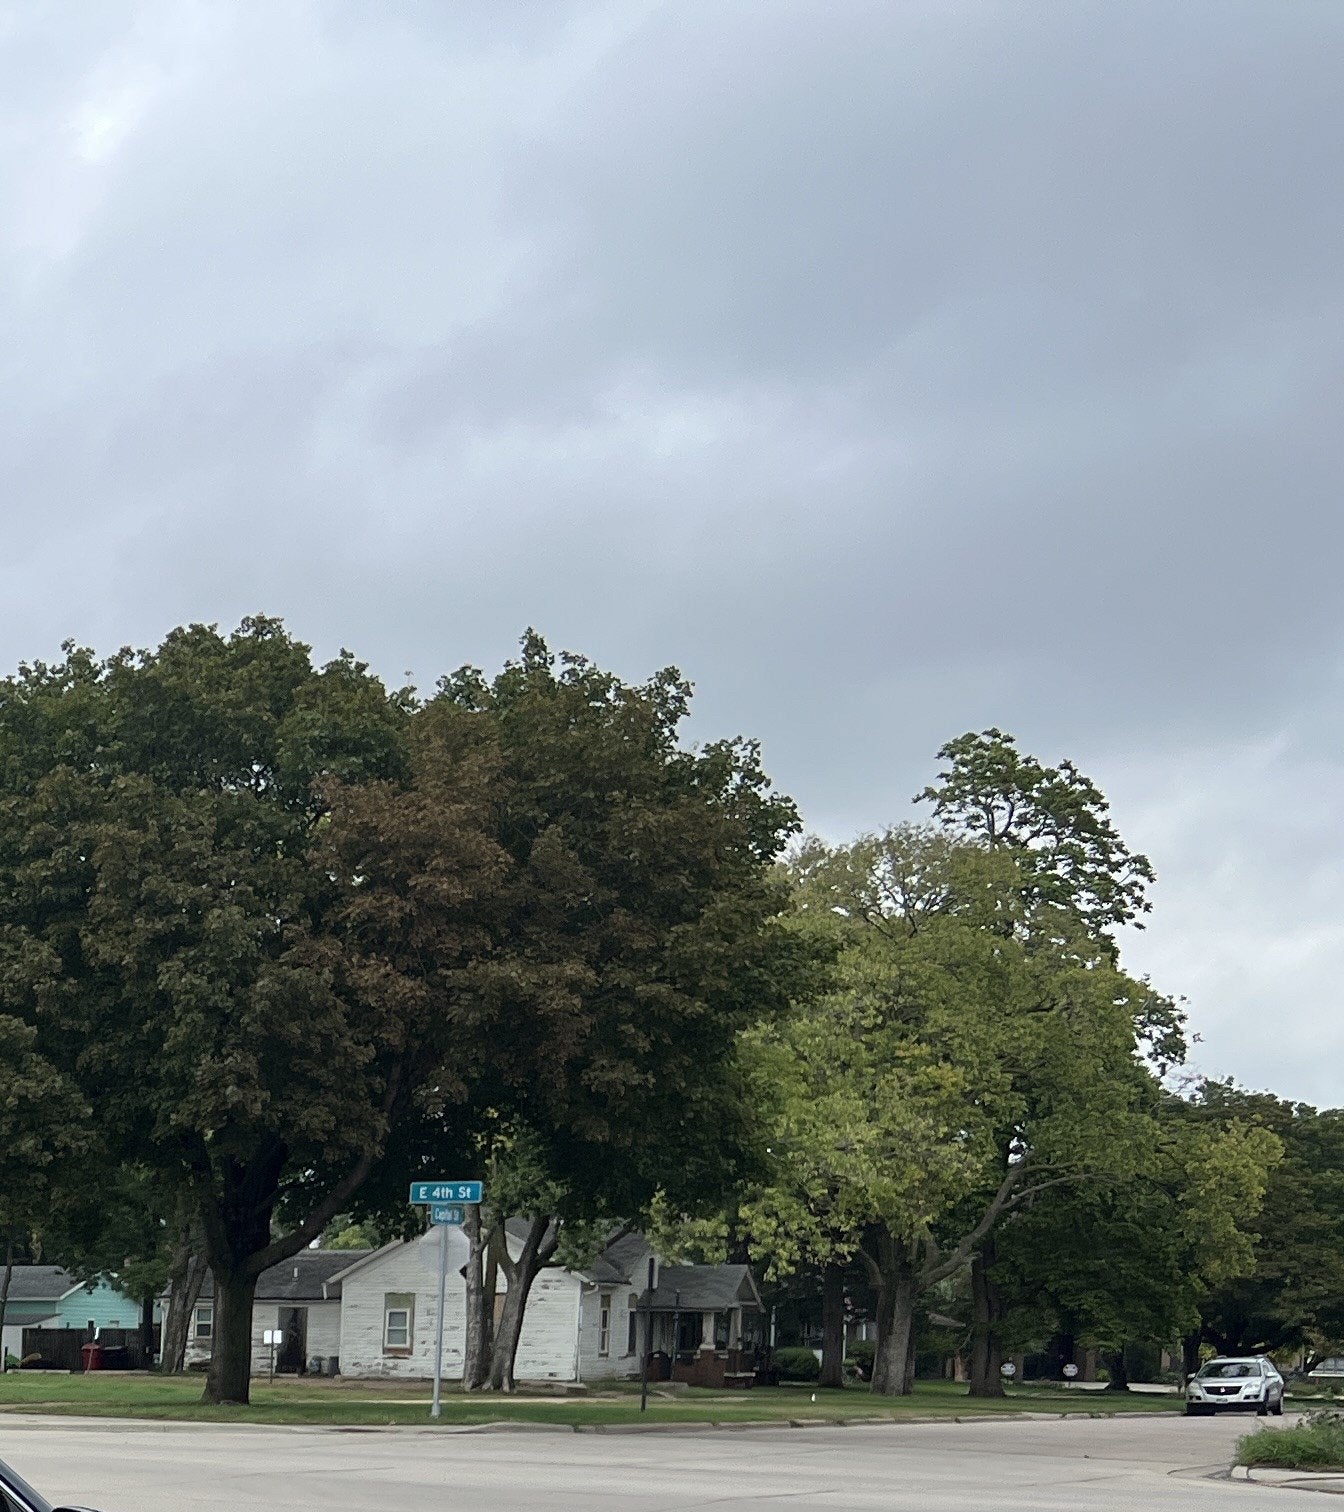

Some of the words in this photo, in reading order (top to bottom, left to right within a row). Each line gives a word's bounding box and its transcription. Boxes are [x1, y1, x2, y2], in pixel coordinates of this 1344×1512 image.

[419, 1186, 427, 1199] E
[432, 1187, 453, 1199] 4th
[458, 1186, 471, 1198] St
